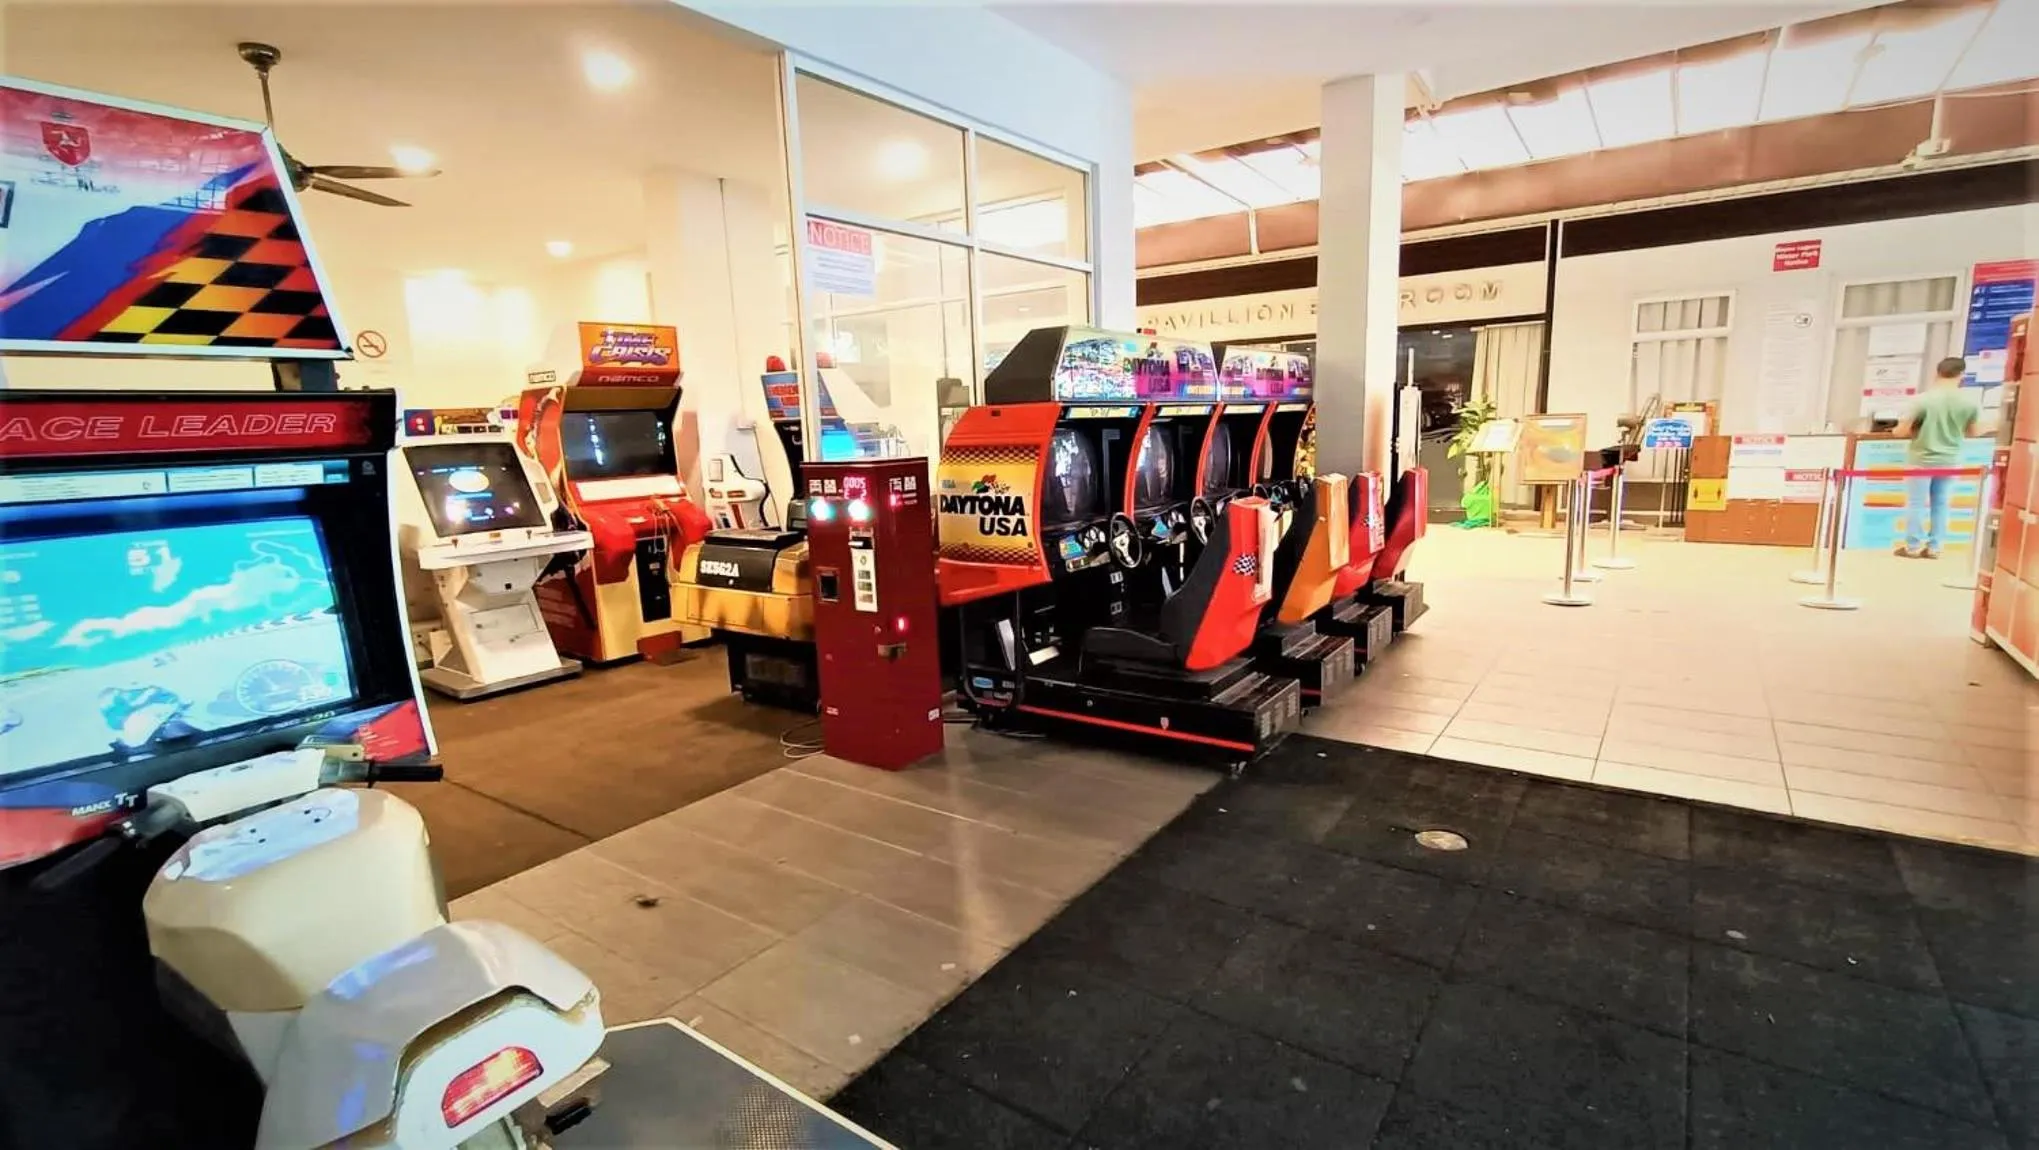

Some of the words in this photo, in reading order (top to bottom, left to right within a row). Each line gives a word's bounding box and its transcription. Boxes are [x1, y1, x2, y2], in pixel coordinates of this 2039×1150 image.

[138, 413, 337, 438] LEADER
[940, 495, 1025, 516] DAYTONA
[979, 517, 1028, 536] USA
[72, 801, 111, 816] MANX
